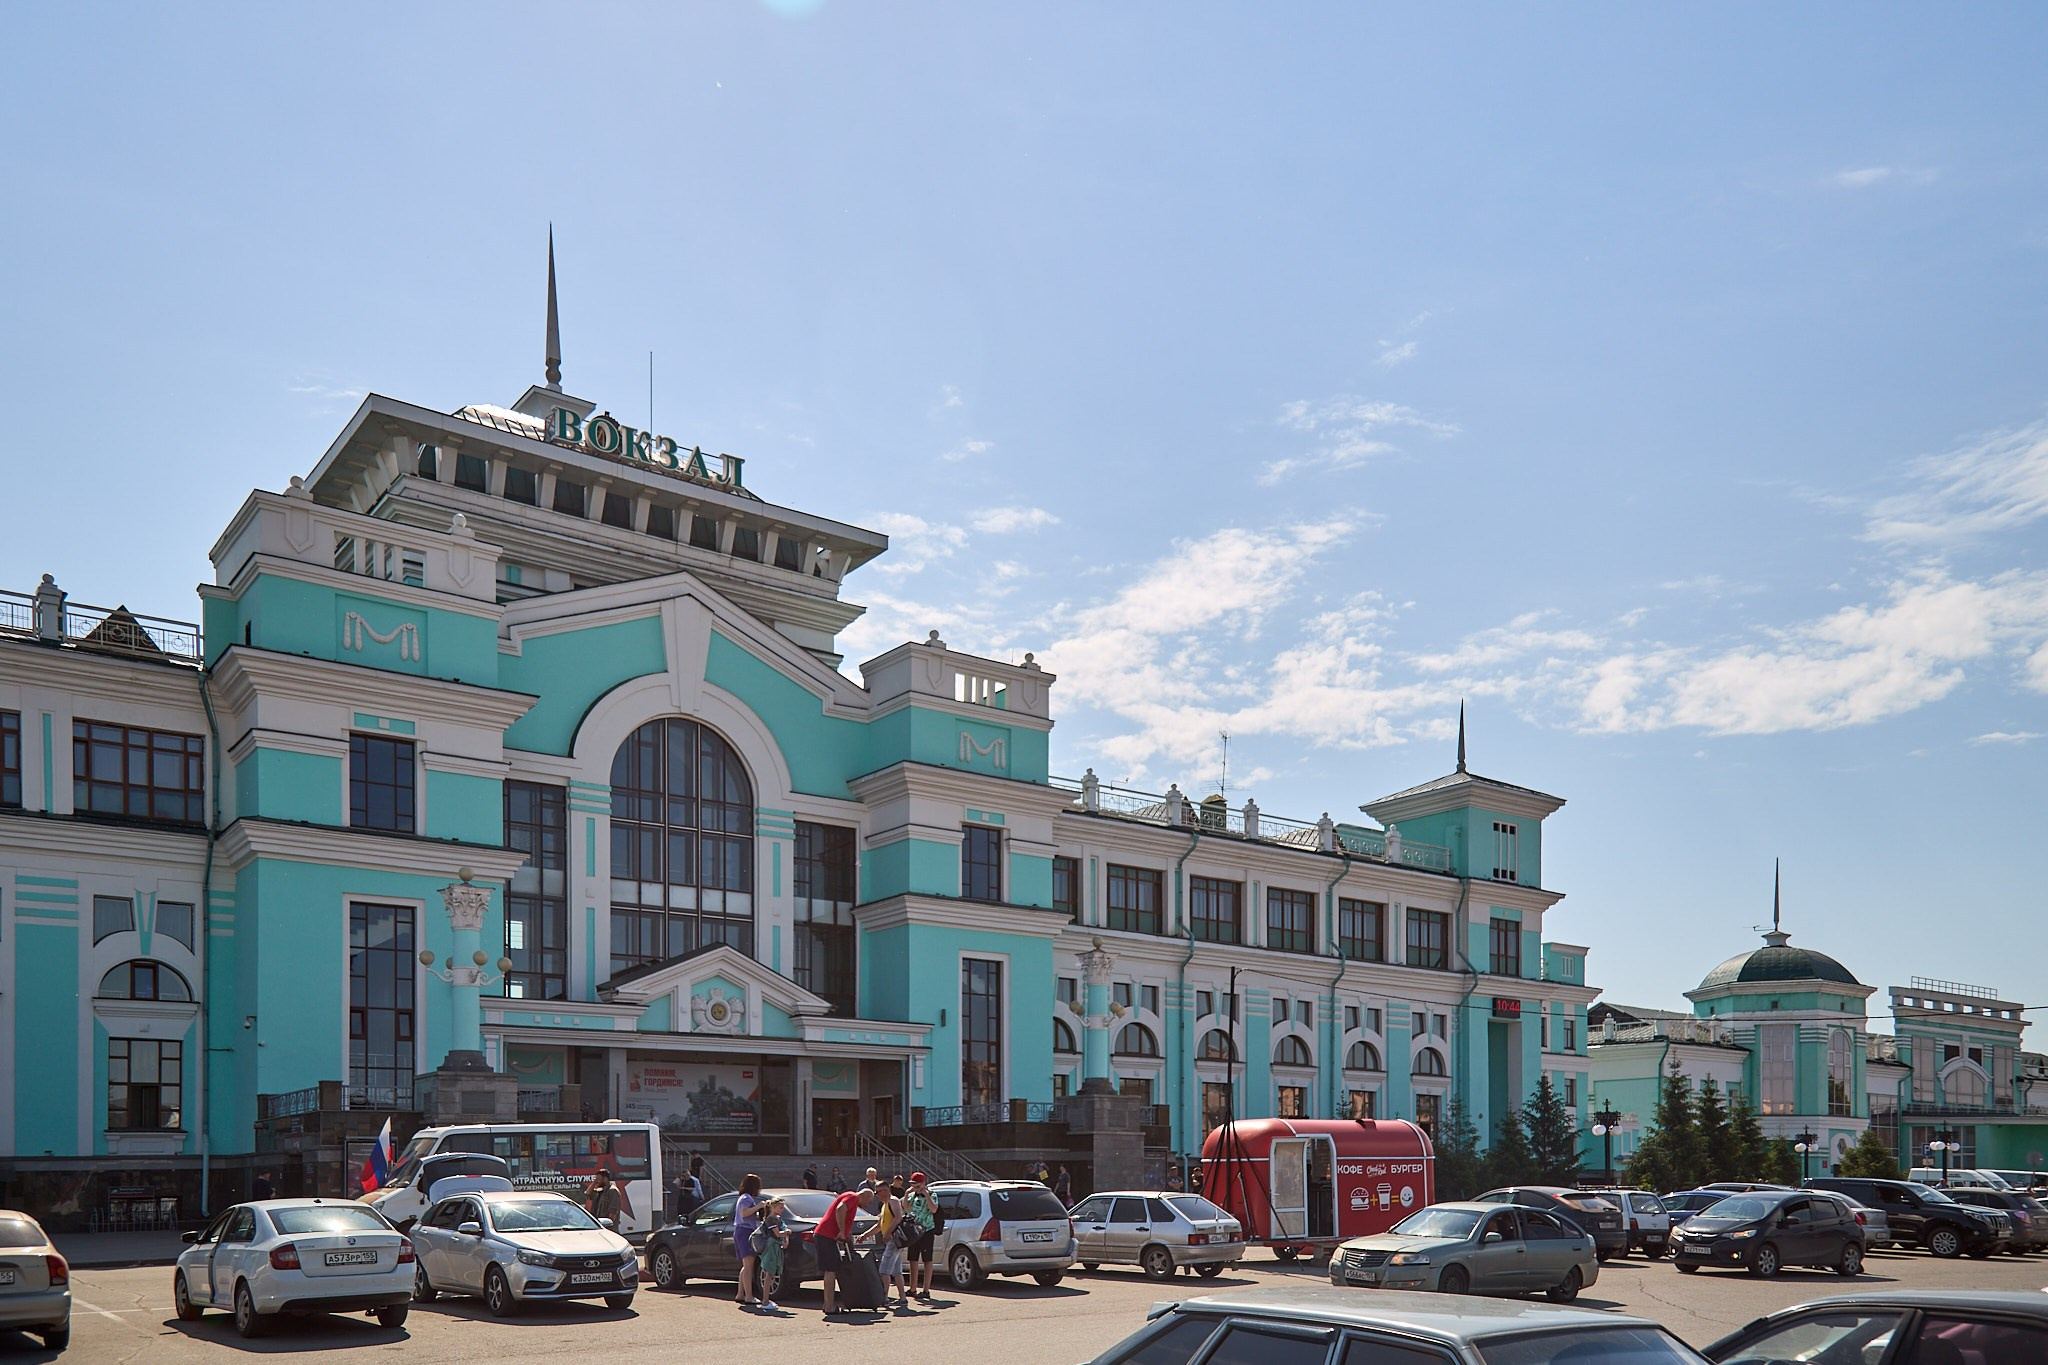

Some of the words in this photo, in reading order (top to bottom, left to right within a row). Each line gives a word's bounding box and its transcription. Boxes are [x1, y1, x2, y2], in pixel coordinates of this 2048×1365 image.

[551, 405, 745, 488] ВОКЗАЛ
[1496, 999, 1520, 1012] 10:44
[644, 1078, 683, 1087] ГОРДИМСЯ!
[1337, 1165, 1363, 1174] КОФЕ
[1391, 1164, 1423, 1173] БУРГЕР
[511, 1176, 564, 1184] НТРАКТНУЮ
